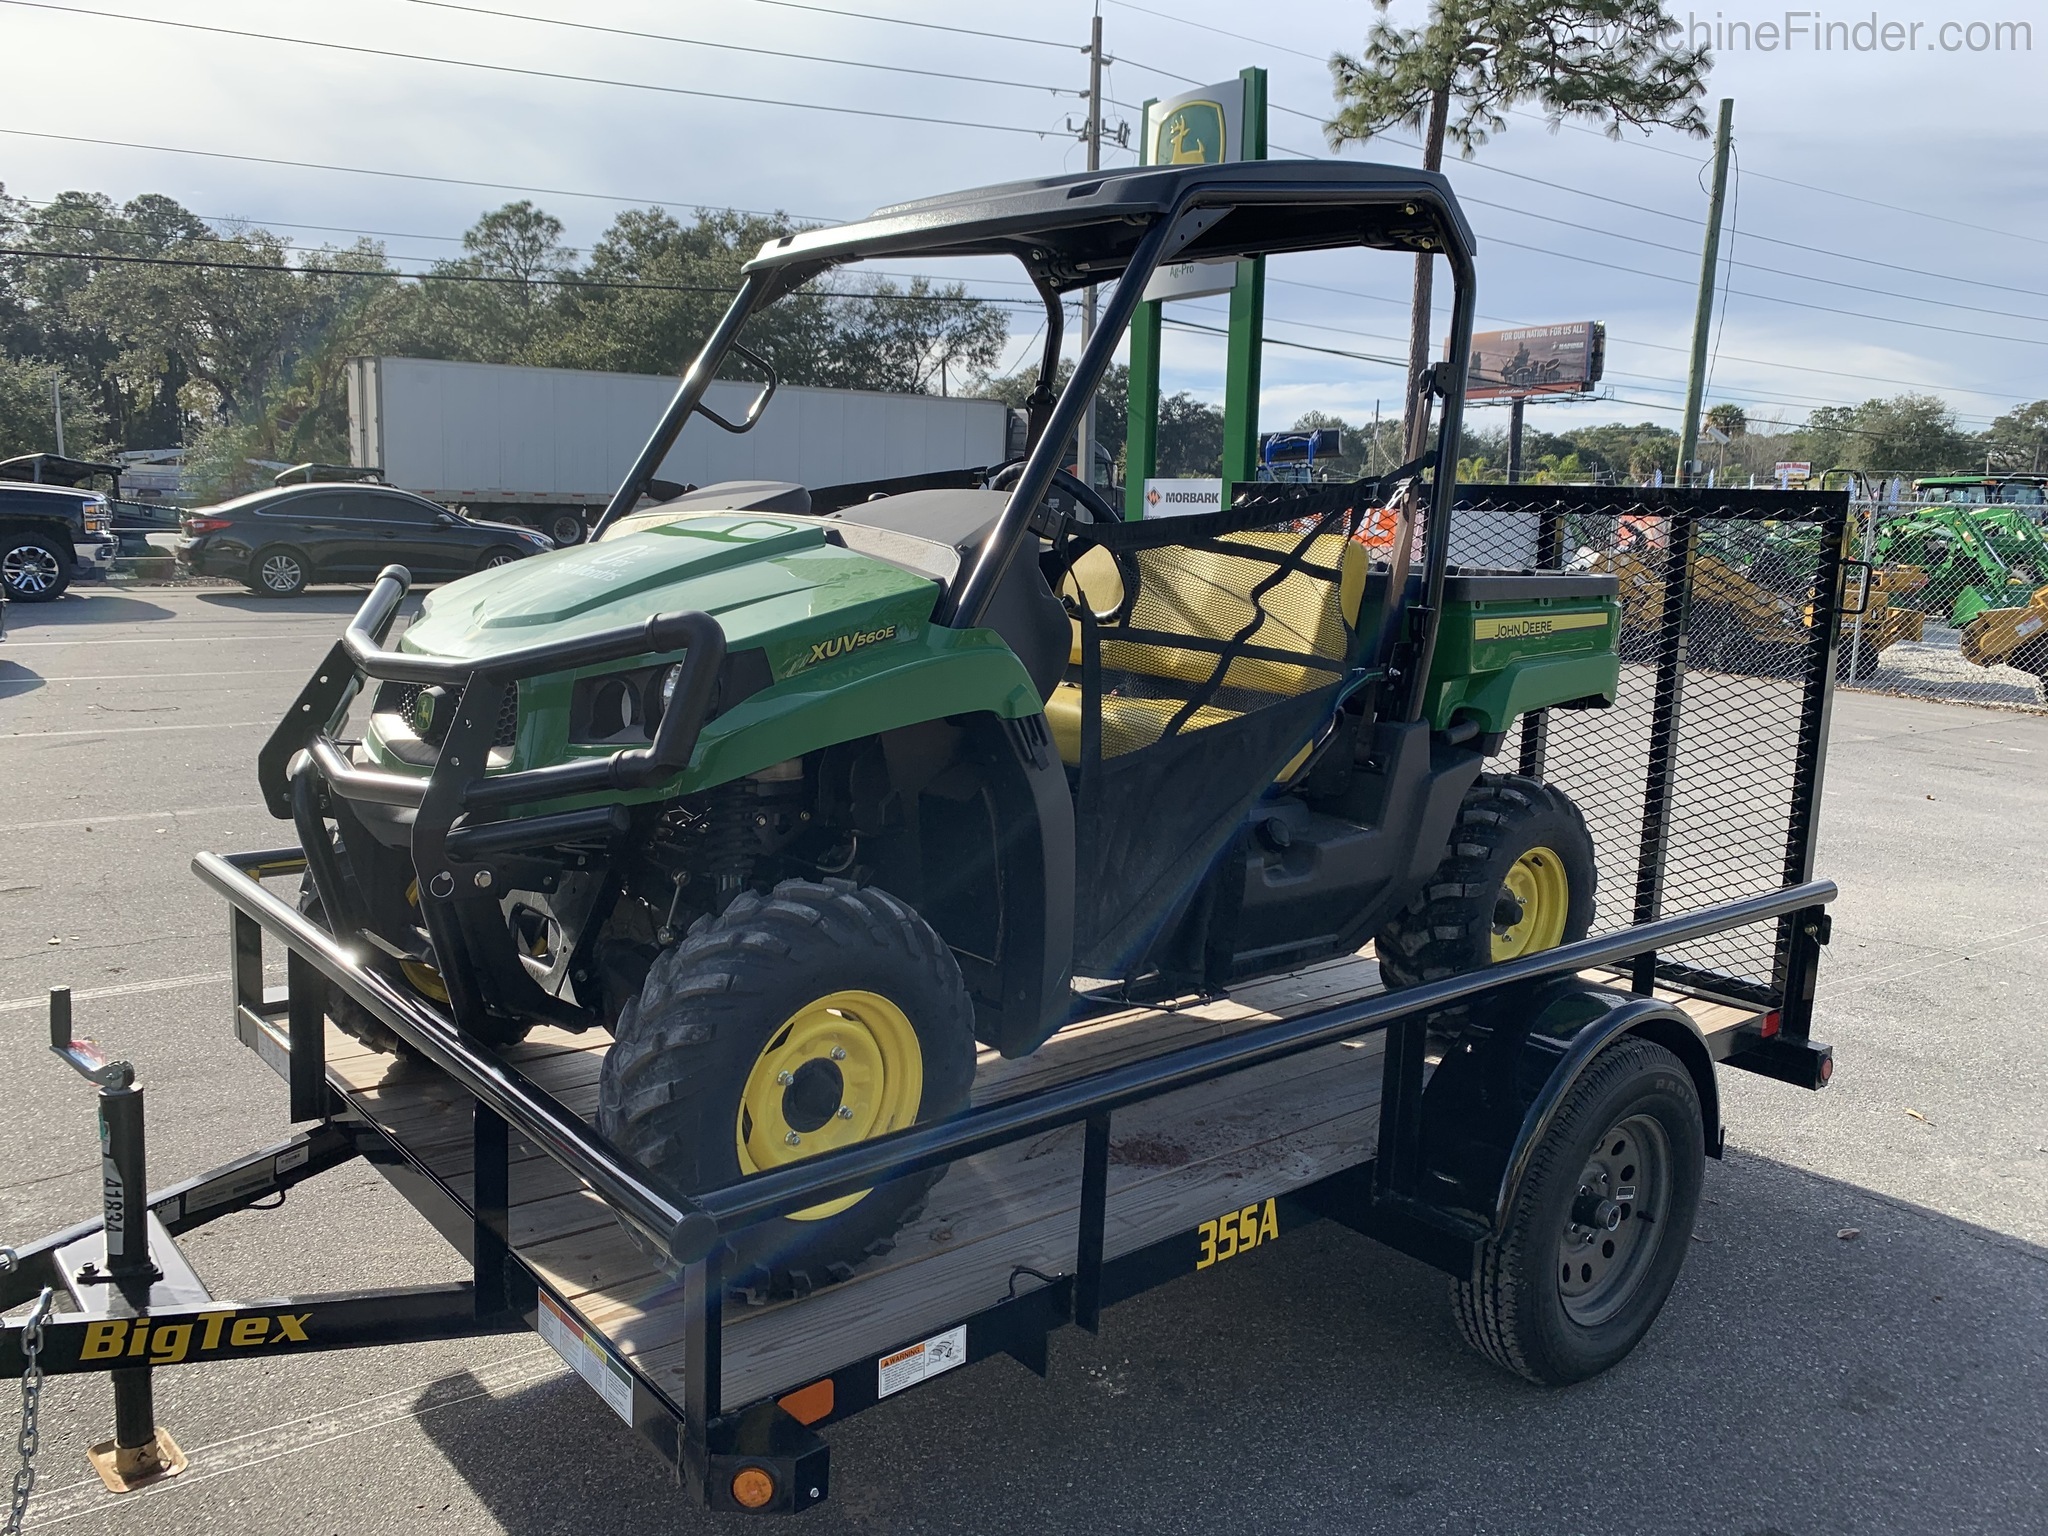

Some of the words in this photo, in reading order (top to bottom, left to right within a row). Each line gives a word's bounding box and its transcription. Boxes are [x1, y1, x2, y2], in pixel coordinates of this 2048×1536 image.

[1169, 263, 1195, 279] Ag-Pro
[1501, 332, 1513, 342] FOR
[1513, 330, 1526, 340] OUR
[1526, 328, 1549, 339] NATION.
[1550, 326, 1562, 337] FOR
[1563, 325, 1572, 335] US
[1572, 324, 1585, 335] ALL.
[1165, 492, 1219, 504] MORBARK
[1494, 623, 1521, 638] JOHN
[1522, 620, 1553, 635] DEERE
[1196, 1196, 1280, 1271] 35SA
[888, 1346, 921, 1366] WARNING
